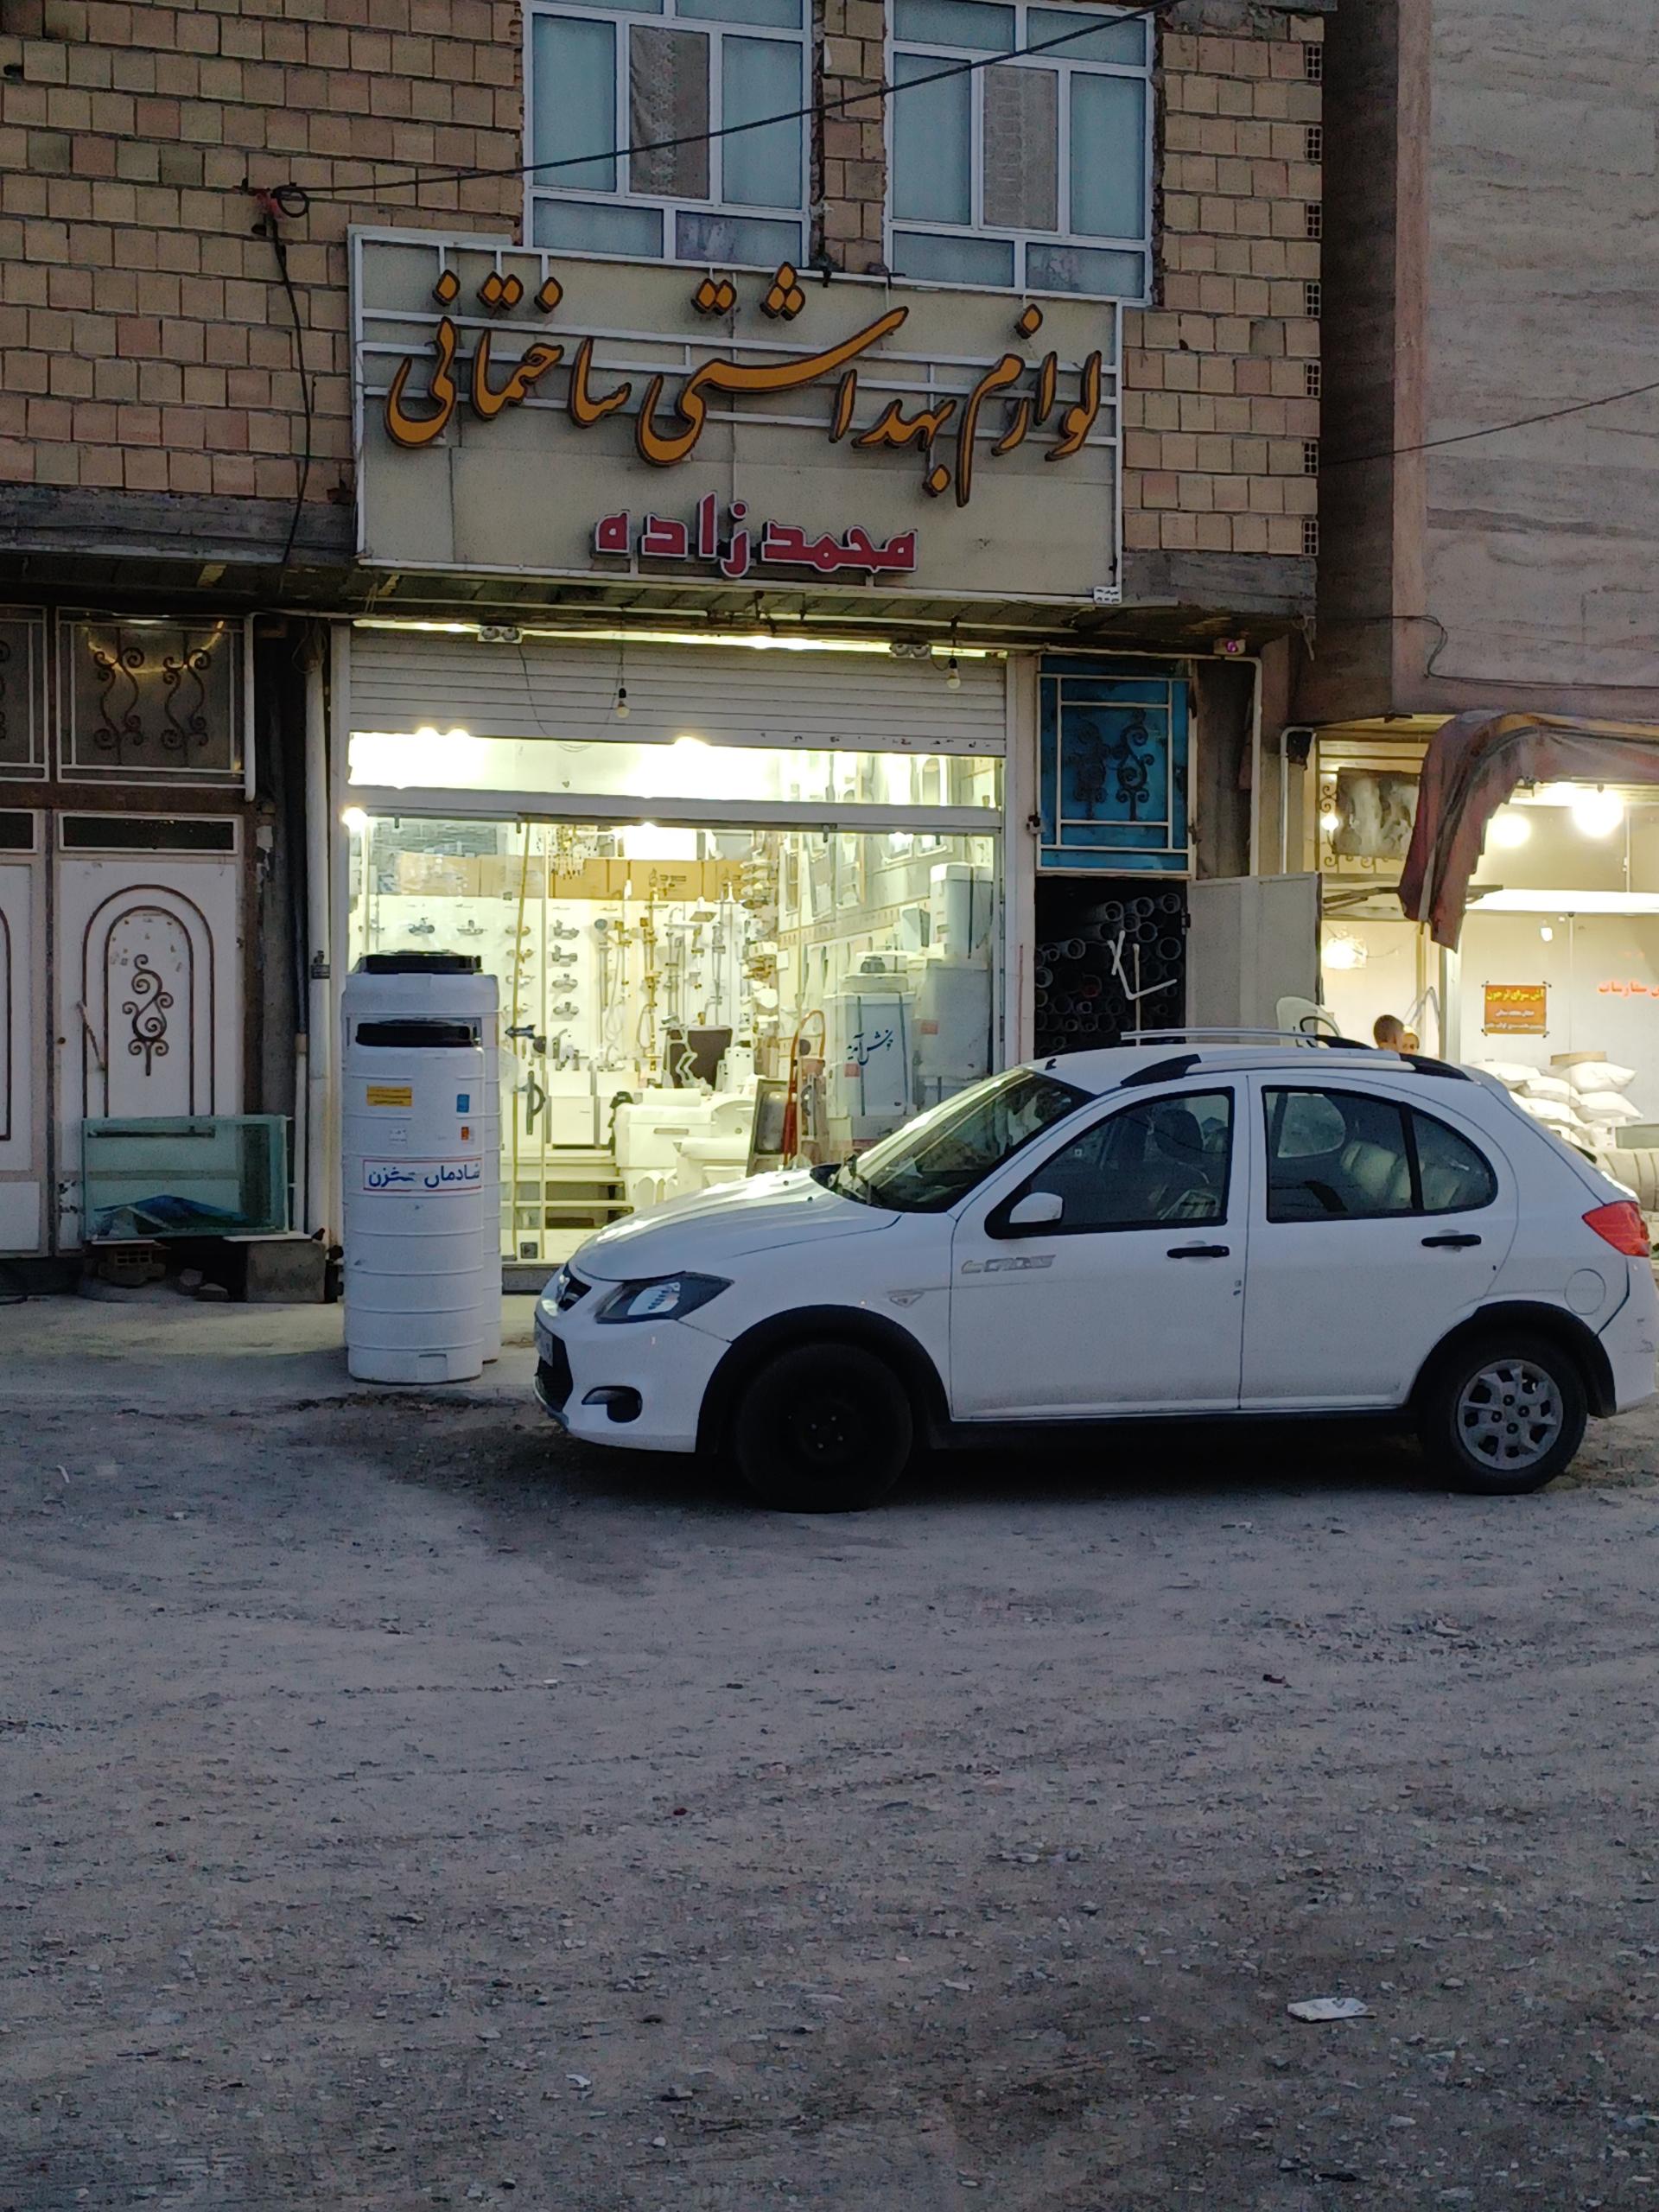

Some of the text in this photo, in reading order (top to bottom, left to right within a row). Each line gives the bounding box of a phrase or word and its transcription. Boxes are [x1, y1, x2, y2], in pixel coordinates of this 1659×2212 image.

[385, 261, 1103, 507] لوازم بهداشتی ساختمانی
